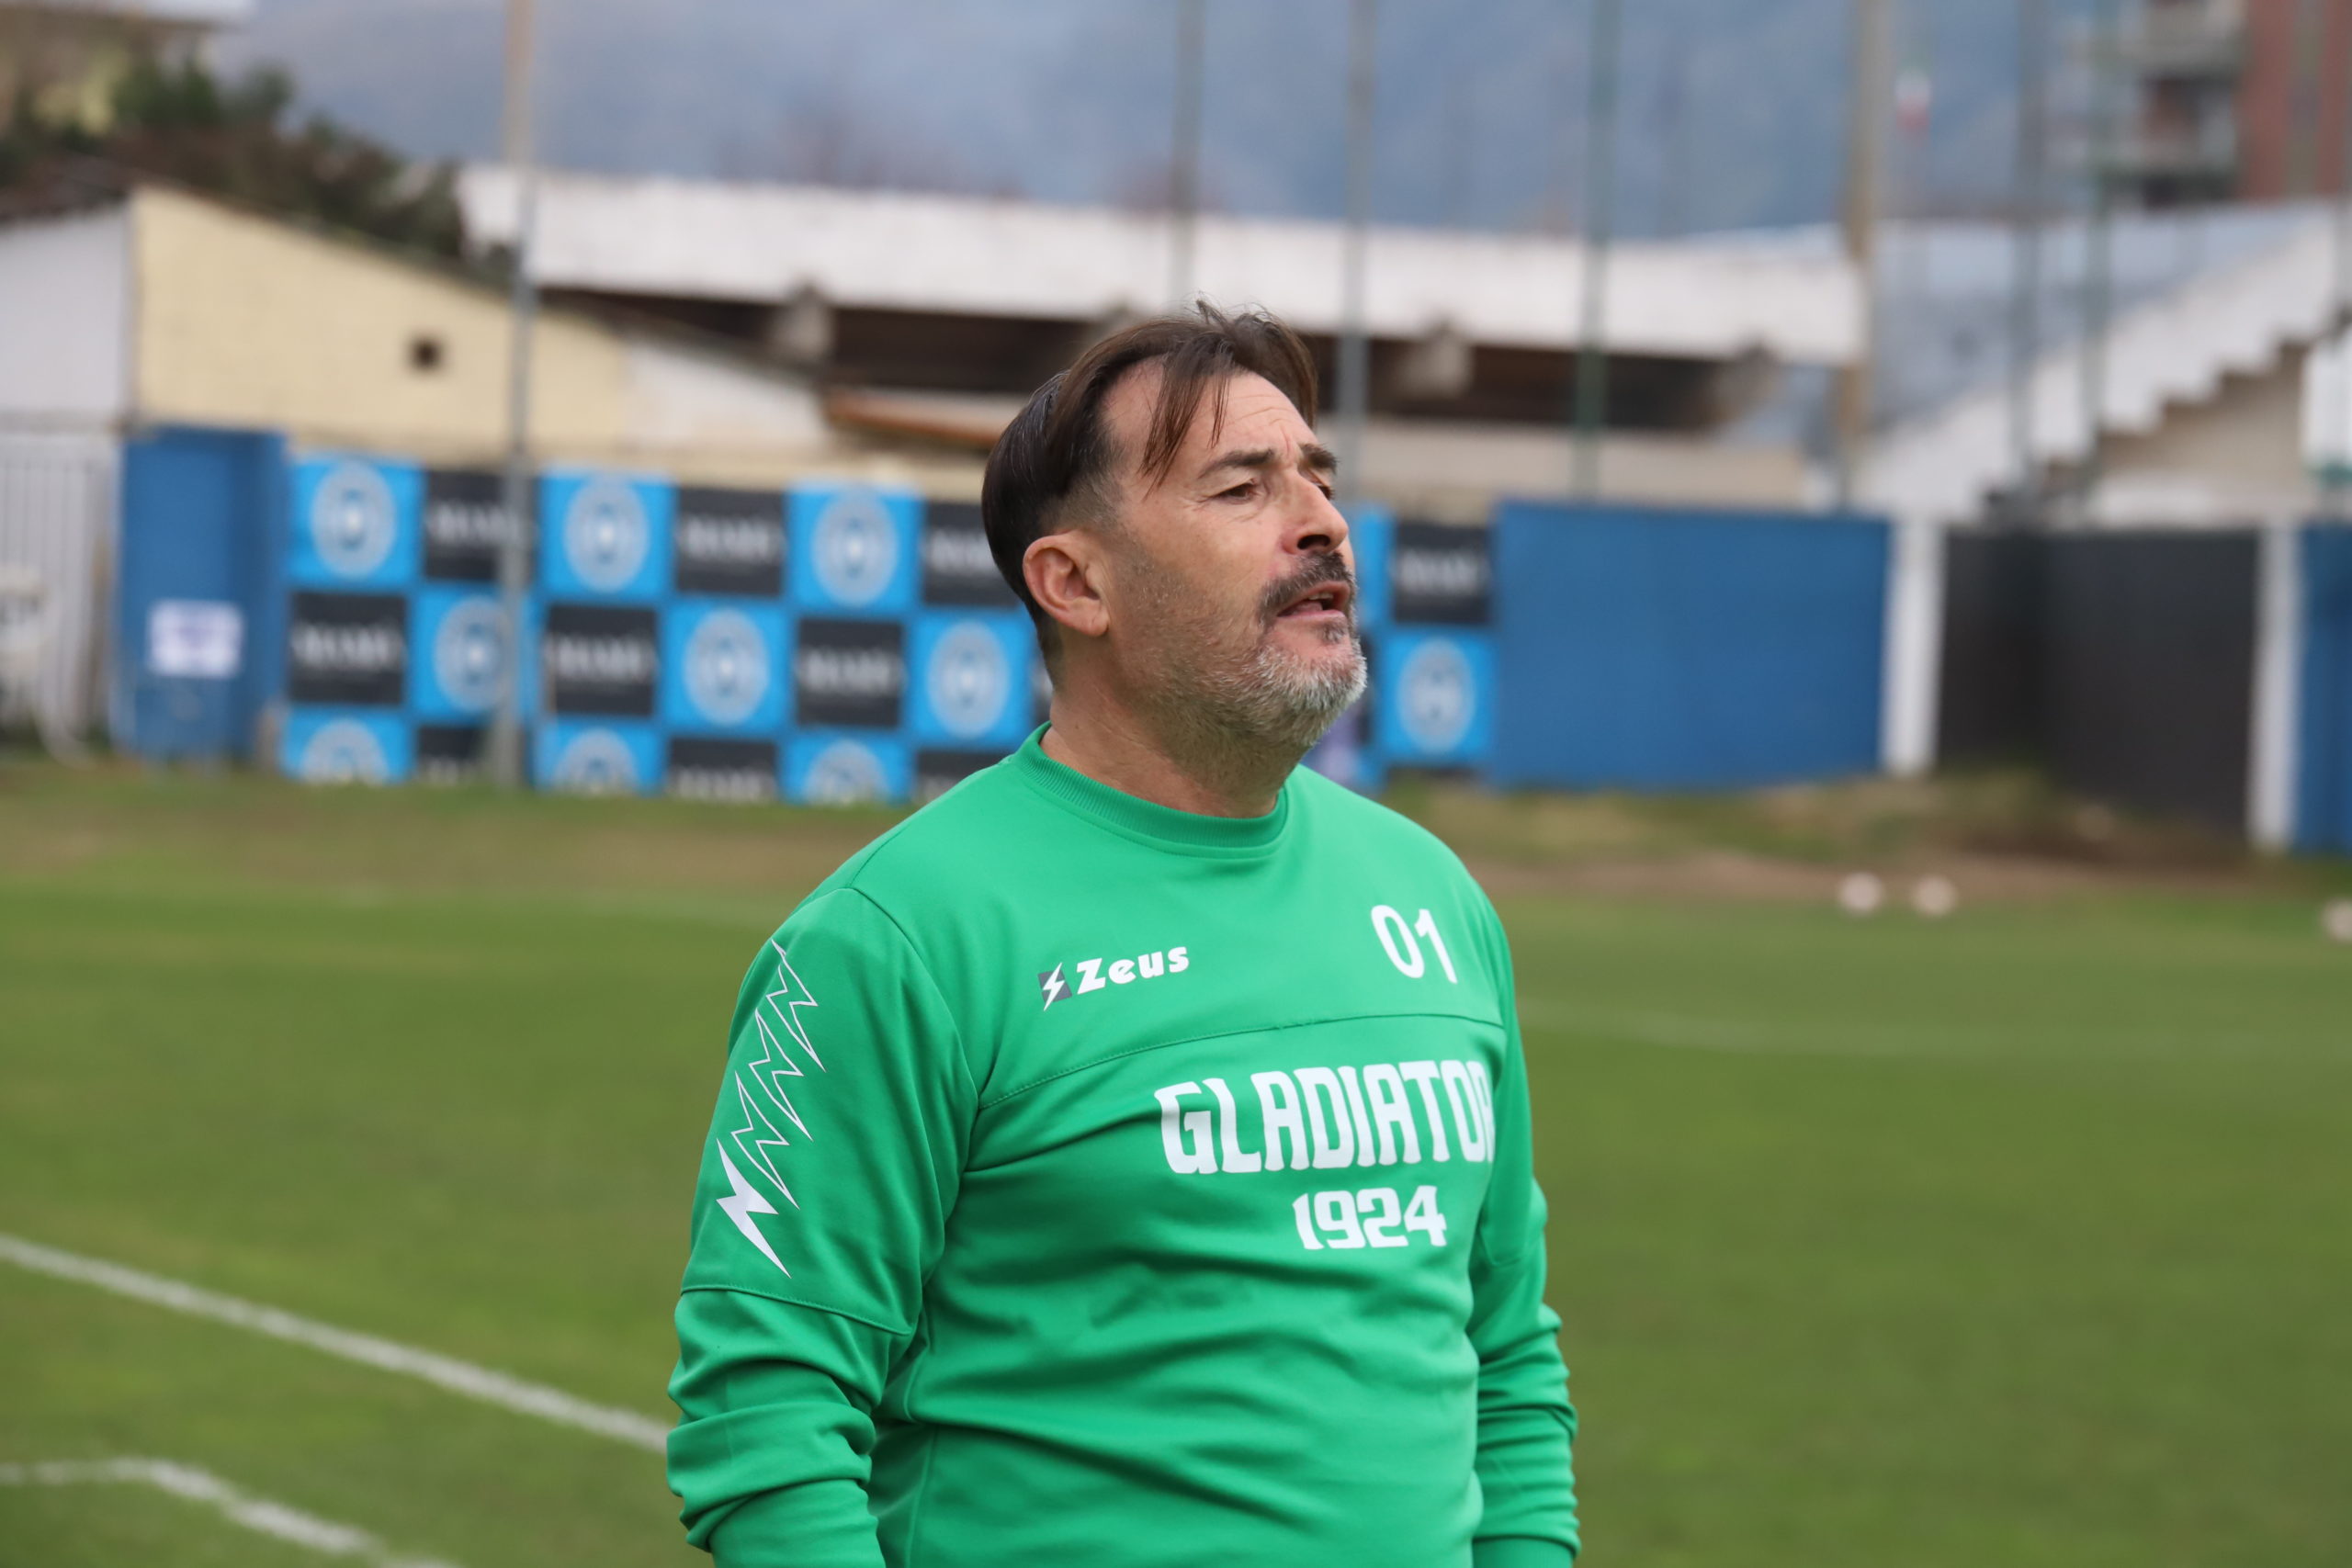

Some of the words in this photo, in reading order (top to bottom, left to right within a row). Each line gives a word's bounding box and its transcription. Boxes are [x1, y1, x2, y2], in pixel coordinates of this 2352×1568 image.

[1076, 946, 1190, 995] Zeus
[1370, 904, 1458, 985] 01
[1292, 1185, 1447, 1250] 1924
